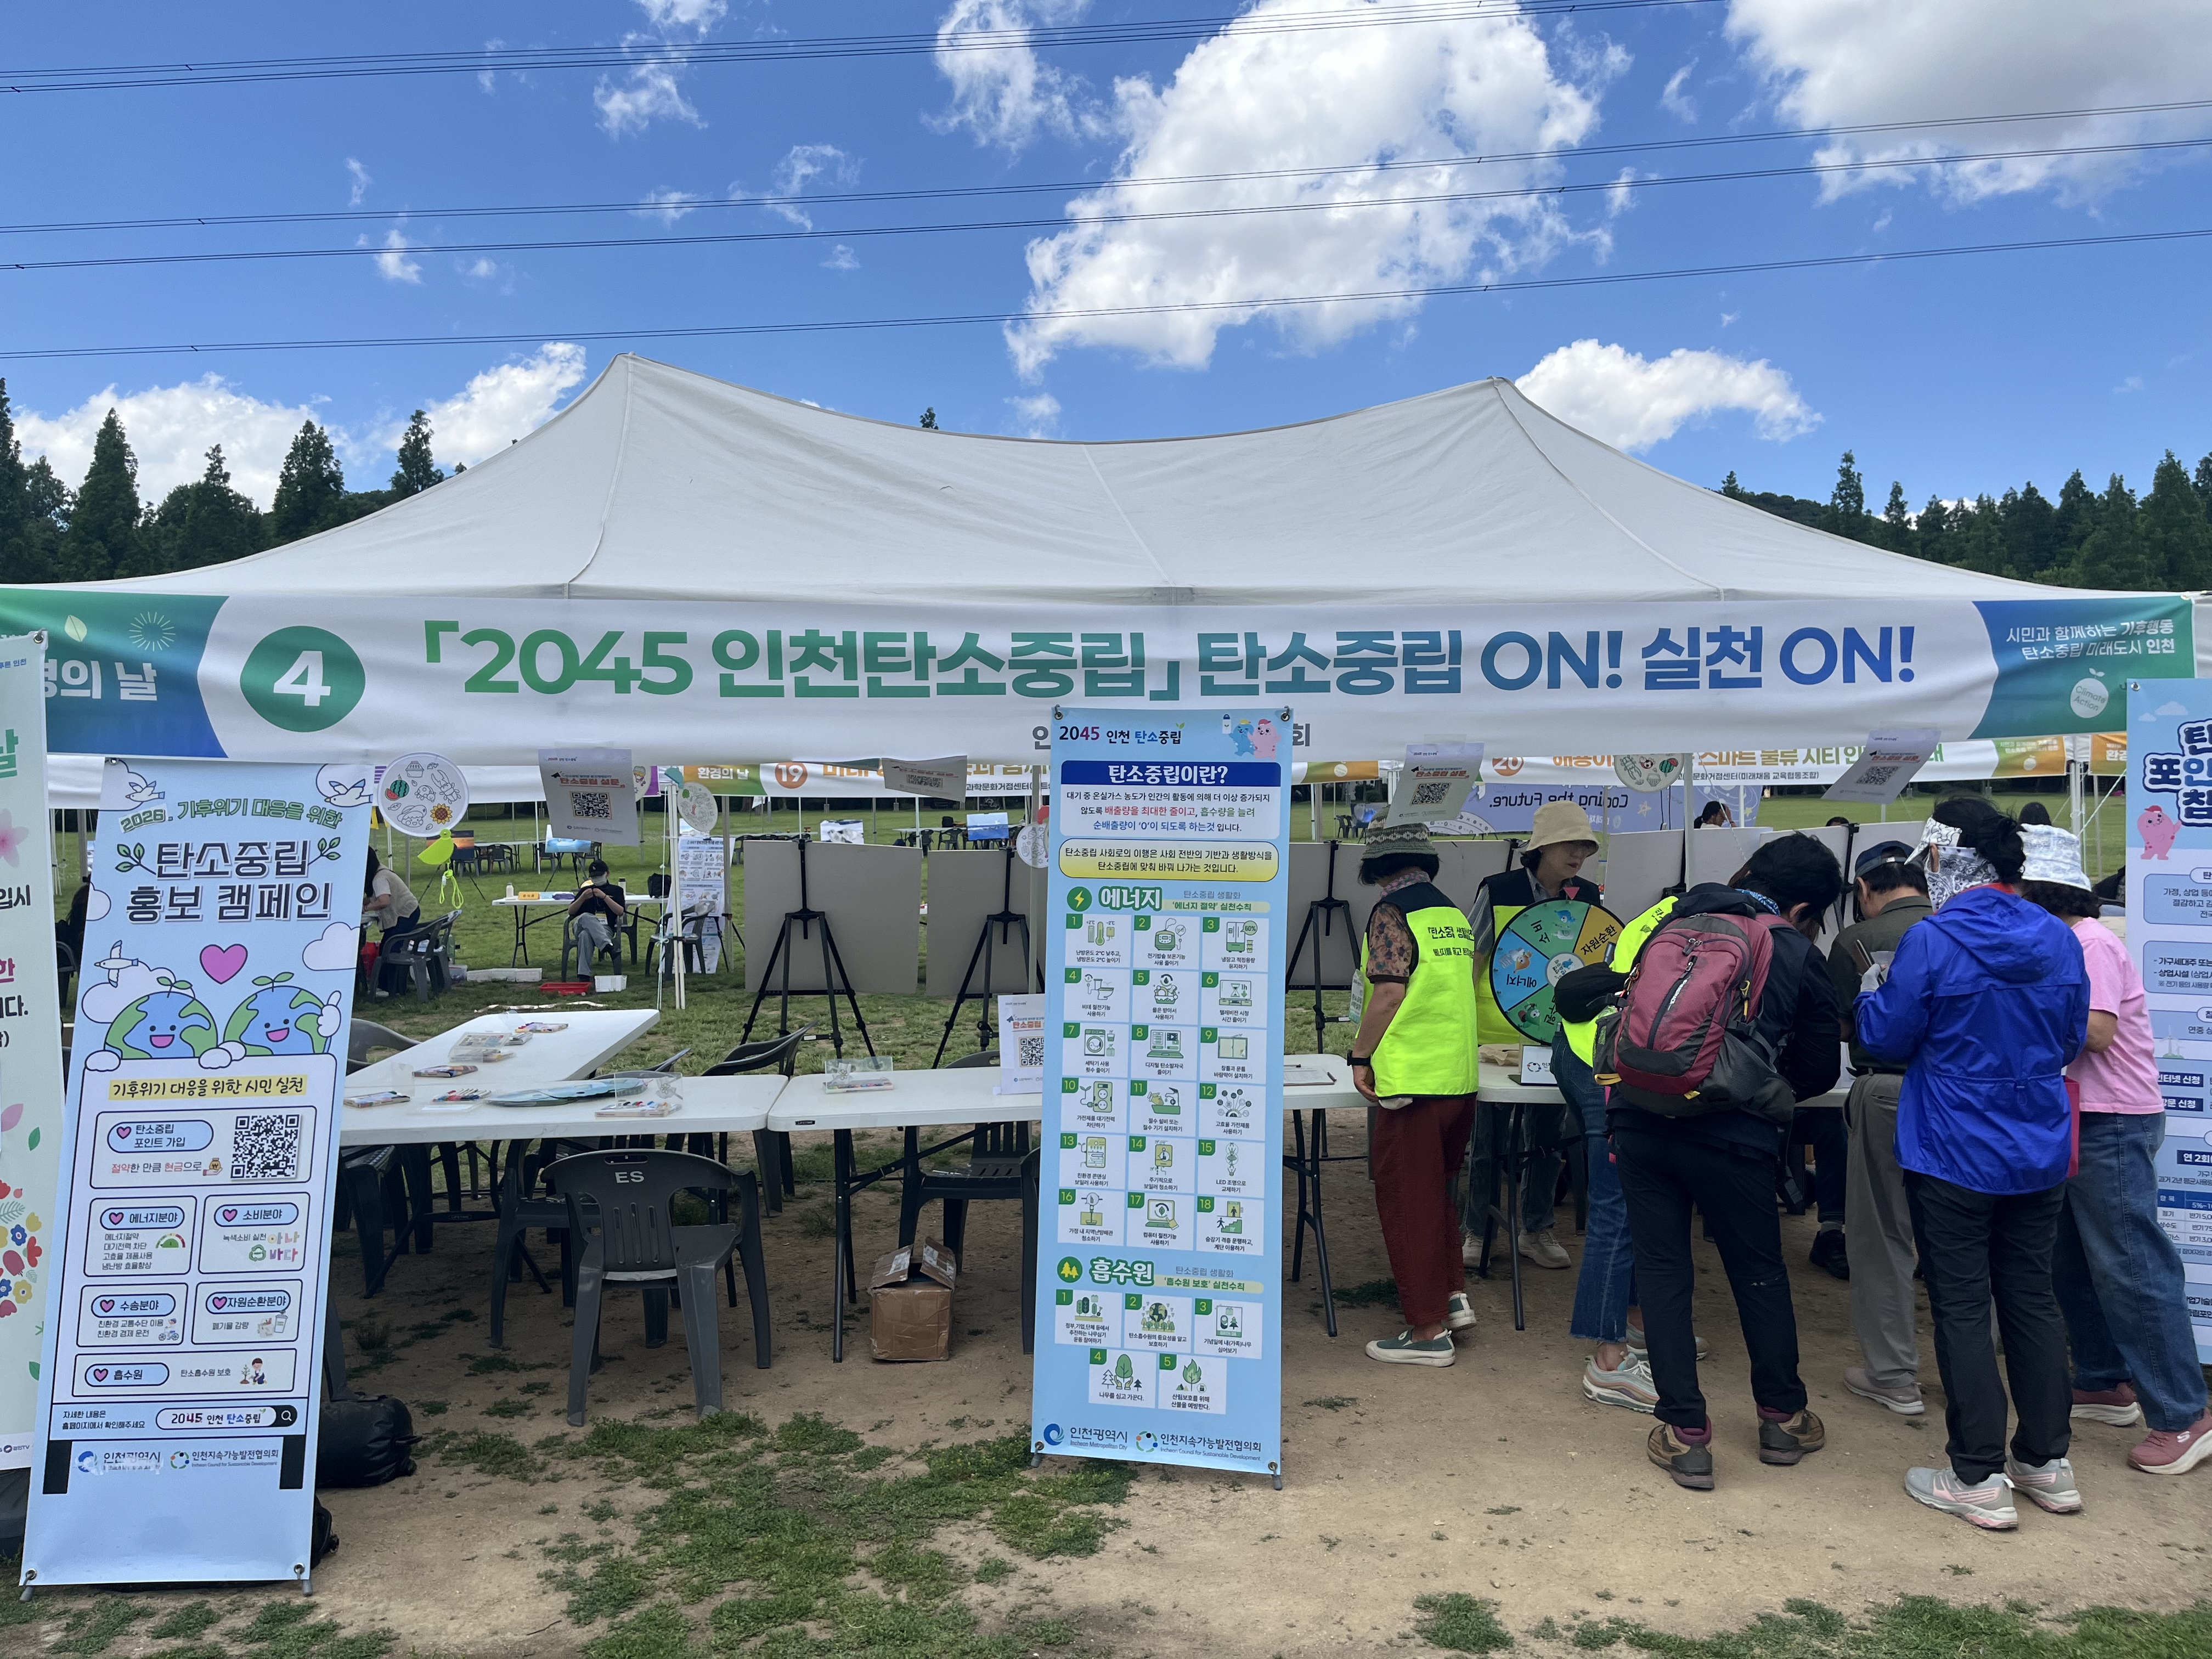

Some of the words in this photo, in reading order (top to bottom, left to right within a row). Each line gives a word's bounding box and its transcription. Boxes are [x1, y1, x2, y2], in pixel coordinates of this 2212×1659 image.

[2006, 627, 2051, 644] 시민과
[2054, 625, 2117, 641] 함께하는
[2022, 643, 2083, 661] 탄소중립
[2086, 640, 2142, 657] 미래도시
[2146, 638, 2175, 654] 인천
[425, 620, 693, 695] 「2045
[712, 629, 1180, 701] 인천탄소중립」
[1197, 629, 1462, 696] 탄소중립
[1481, 630, 1624, 691] ON!
[1642, 625, 1763, 691] 실천
[1779, 625, 1915, 685] ON!
[115, 663, 157, 701] 날
[273, 650, 331, 707] 4
[2075, 685, 2106, 703] Climate
[2073, 696, 2098, 712] Action
[1059, 726, 1100, 741] 2045
[1107, 730, 1130, 744] 인천
[1135, 730, 1181, 744] 탄소중립
[1802, 747, 1839, 765] 시티
[698, 767, 733, 779] 환경의
[737, 769, 749, 780] 날
[777, 765, 803, 782] 19
[1109, 765, 1228, 784] 탄소중립이란?
[1084, 792, 1090, 800] 중
[1093, 792, 1122, 801] 온실가스
[1125, 793, 1146, 801] 농도가
[1148, 793, 1170, 801] 인간의
[1172, 793, 1194, 802] 활동에
[1197, 793, 1211, 802] 의해
[1214, 793, 1221, 802] 더
[1223, 793, 1238, 802] 이상
[1240, 793, 1270, 803] 증가되지
[178, 799, 247, 819] 기후위기
[252, 799, 304, 820] 대응을
[306, 806, 342, 830] 위한
[1081, 807, 1102, 815] 않도록
[1105, 806, 1139, 816] 배출량을
[1142, 807, 1167, 816] 최대한
[1170, 807, 1198, 817] 줄이고,
[1200, 807, 1236, 817] 흡수량을
[1238, 808, 1255, 817] 늘려
[1093, 821, 1136, 831] 순배출량이
[1161, 822, 1186, 831] 되도록
[1189, 822, 1215, 831] 하는것
[1217, 823, 1242, 832] 입니다.
[156, 840, 311, 880] 탄소중립
[1065, 848, 1097, 857] 탄소중립
[1100, 848, 1131, 857] 사회로의
[1134, 849, 1158, 858] 이행은
[1160, 850, 1176, 859] 사회
[1178, 850, 1202, 859] 전반의
[1205, 850, 1229, 859] 기반과
[1232, 851, 1272, 860] 생활방식을
[1098, 862, 1137, 871] 탄소중립에
[1140, 862, 1156, 872] 맞춰
[1159, 863, 1175, 872] 바꿔
[1177, 864, 1201, 872] 나가는
[1204, 864, 1239, 873] 것입니다.
[1184, 890, 1215, 899] 탄소중립
[1217, 890, 1240, 900] 생활화
[2163, 888, 2181, 896] 가정,
[127, 884, 203, 924] 홍보
[218, 881, 332, 922] 캠페인
[1101, 888, 1161, 909] 에너지
[2172, 899, 2204, 907] 절감하고
[1221, 902, 1251, 911] 실천수칙
[1531, 919, 1550, 944] 소비
[1581, 924, 1618, 955] 자원순환
[2159, 957, 2197, 966] 가구세대주
[2159, 969, 2189, 978] 상업시설
[1506, 974, 1537, 988] 에너지
[2183, 1075, 2200, 1084] 신청
[113, 1080, 165, 1098] 기후위기
[171, 1079, 207, 1097] 대응을
[212, 1079, 242, 1094] 위한
[245, 1079, 272, 1094] 시민
[276, 1077, 303, 1093] 실천
[2178, 1099, 2196, 1108] 신청
[136, 1124, 174, 1135] 탄소중립
[134, 1137, 163, 1148] 포인트
[166, 1136, 185, 1148] 가입
[112, 1163, 139, 1173] 절약한
[143, 1163, 161, 1173] 만큼
[165, 1162, 202, 1173] 현금으로
[615, 1171, 645, 1183] ES
[129, 1212, 178, 1224] 에너지분야
[242, 1209, 283, 1221] 소비분야
[223, 1234, 250, 1242] 녹색소비
[253, 1233, 267, 1242] 실천
[270, 1248, 298, 1262] 바다
[1092, 1260, 1152, 1284] 흡수원
[1176, 1266, 1207, 1276] 탄소중립
[1210, 1268, 1233, 1277] 생활화
[1213, 1280, 1245, 1290] 실천수칙
[120, 1300, 159, 1311] 수송분야
[227, 1296, 286, 1307] 자원순환분야
[114, 1370, 143, 1380] 흡수원
[63, 1410, 84, 1419] 자세한
[172, 1413, 203, 1424] 2045
[207, 1414, 223, 1425] 인천
[227, 1413, 261, 1424] 탄소중립
[63, 1421, 103, 1430] 홈페이지에서
[105, 1420, 145, 1429] 확인해주세요
[1070, 1427, 1127, 1442] 인천광역시
[1089, 1441, 1117, 1449] Metropolitan
[1161, 1434, 1261, 1452] 인천지속가능발전협의회
[192, 1449, 279, 1460] 인천지속가능발전협의회
